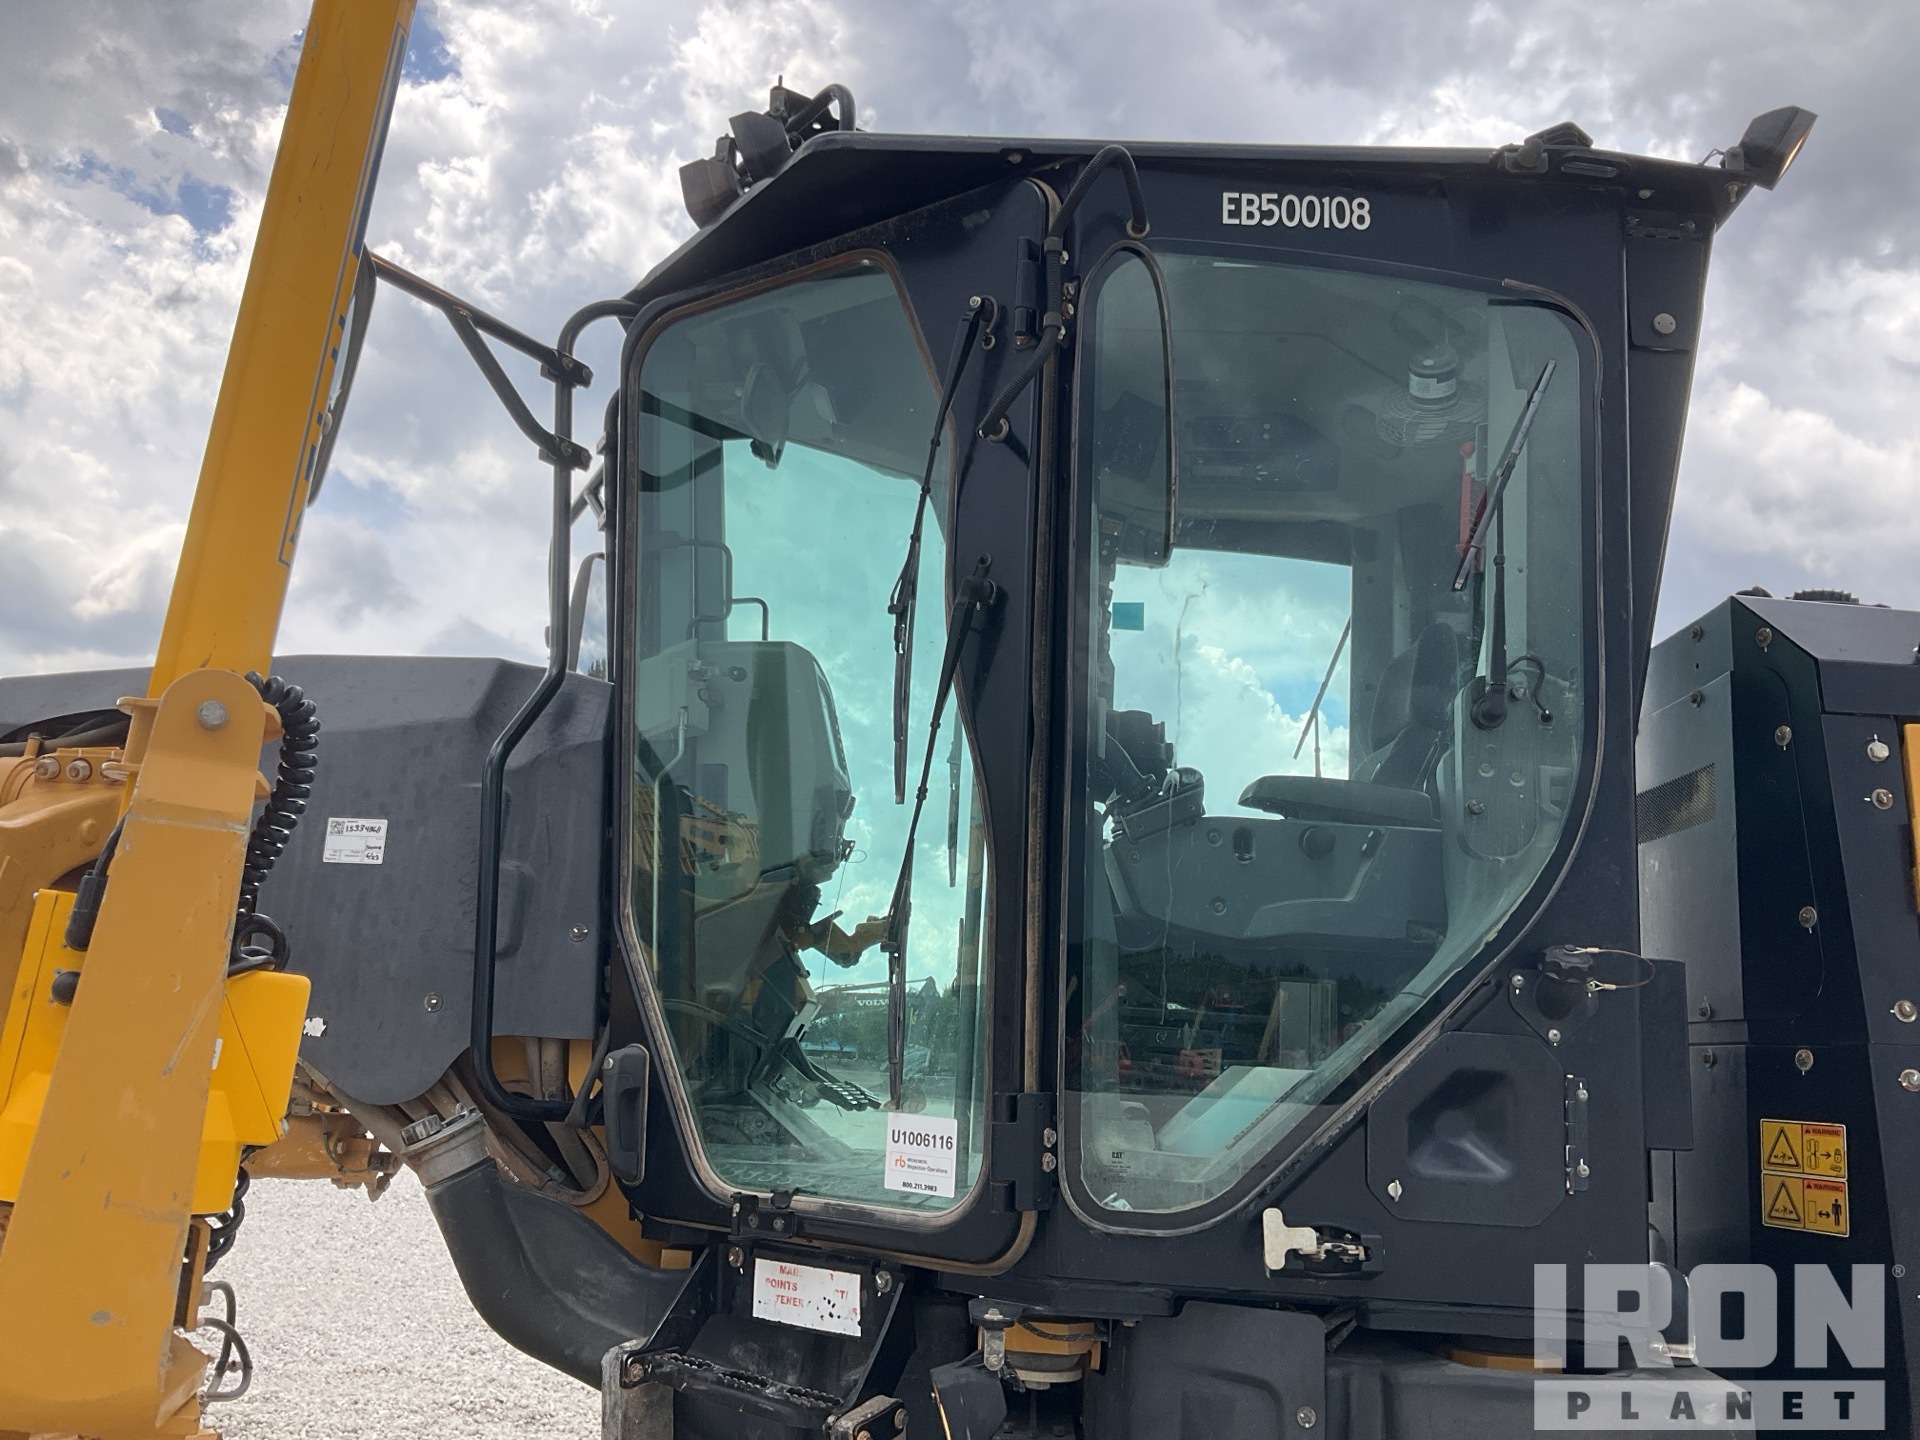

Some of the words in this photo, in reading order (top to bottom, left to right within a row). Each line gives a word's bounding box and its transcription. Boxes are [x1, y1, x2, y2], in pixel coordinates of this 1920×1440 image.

[1222, 192, 1371, 231] EB500108
[1812, 1128, 1842, 1137] WARNING
[891, 1129, 954, 1151] U1006116
[1111, 1151, 1123, 1159] CAT
[1813, 1183, 1844, 1193] WARNING
